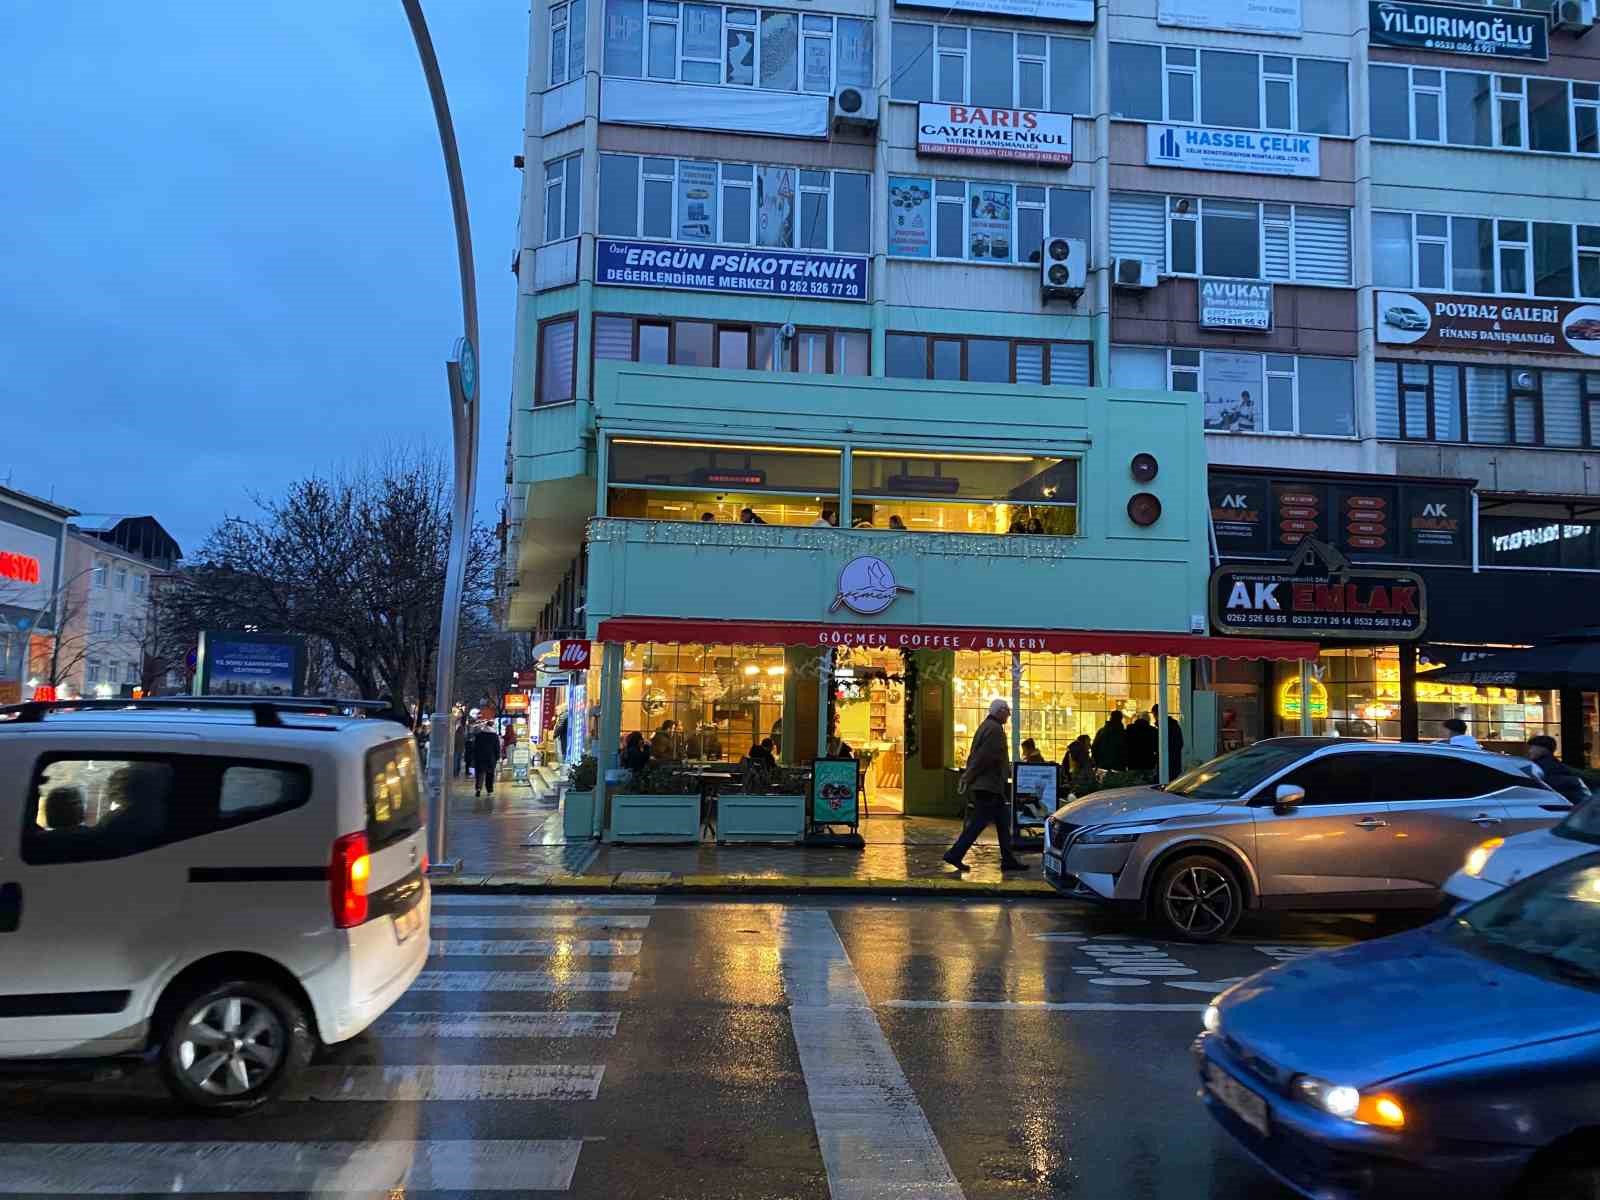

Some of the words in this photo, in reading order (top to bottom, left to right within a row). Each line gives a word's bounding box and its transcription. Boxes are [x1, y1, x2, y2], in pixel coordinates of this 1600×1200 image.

[1380, 11, 1533, 44] YILDIRIMOĞLU
[920, 125, 1068, 145] GAYRİMENKUL
[1186, 130, 1256, 149] HASSEL
[1259, 136, 1311, 154] ÇELİK
[626, 247, 705, 270] ERGÜN
[710, 252, 857, 279] PSİKOTEKNİK
[607, 268, 715, 287] DEĞERLENDİRME
[719, 275, 775, 290] MERKEZİ
[780, 280, 787, 290] 0
[789, 280, 808, 292] 262
[810, 282, 829, 294] 526
[831, 283, 844, 295] 77
[846, 284, 859, 296] 20
[1203, 282, 1270, 299] AVUKAT
[1435, 302, 1499, 319] POYRAZ
[1501, 306, 1560, 323] GALERİ
[1439, 327, 1478, 339] FİNANS
[1480, 331, 1556, 344] DANIŞMANLIĞI
[1221, 494, 1248, 508] AK
[1422, 503, 1449, 518] AK
[1226, 581, 1281, 610] AK
[1291, 583, 1420, 614] EMLAK
[819, 630, 888, 646] GÖÇMEN
[899, 634, 961, 648] COFFEE
[986, 636, 1048, 650] BAKERY
[562, 643, 588, 665] illy
